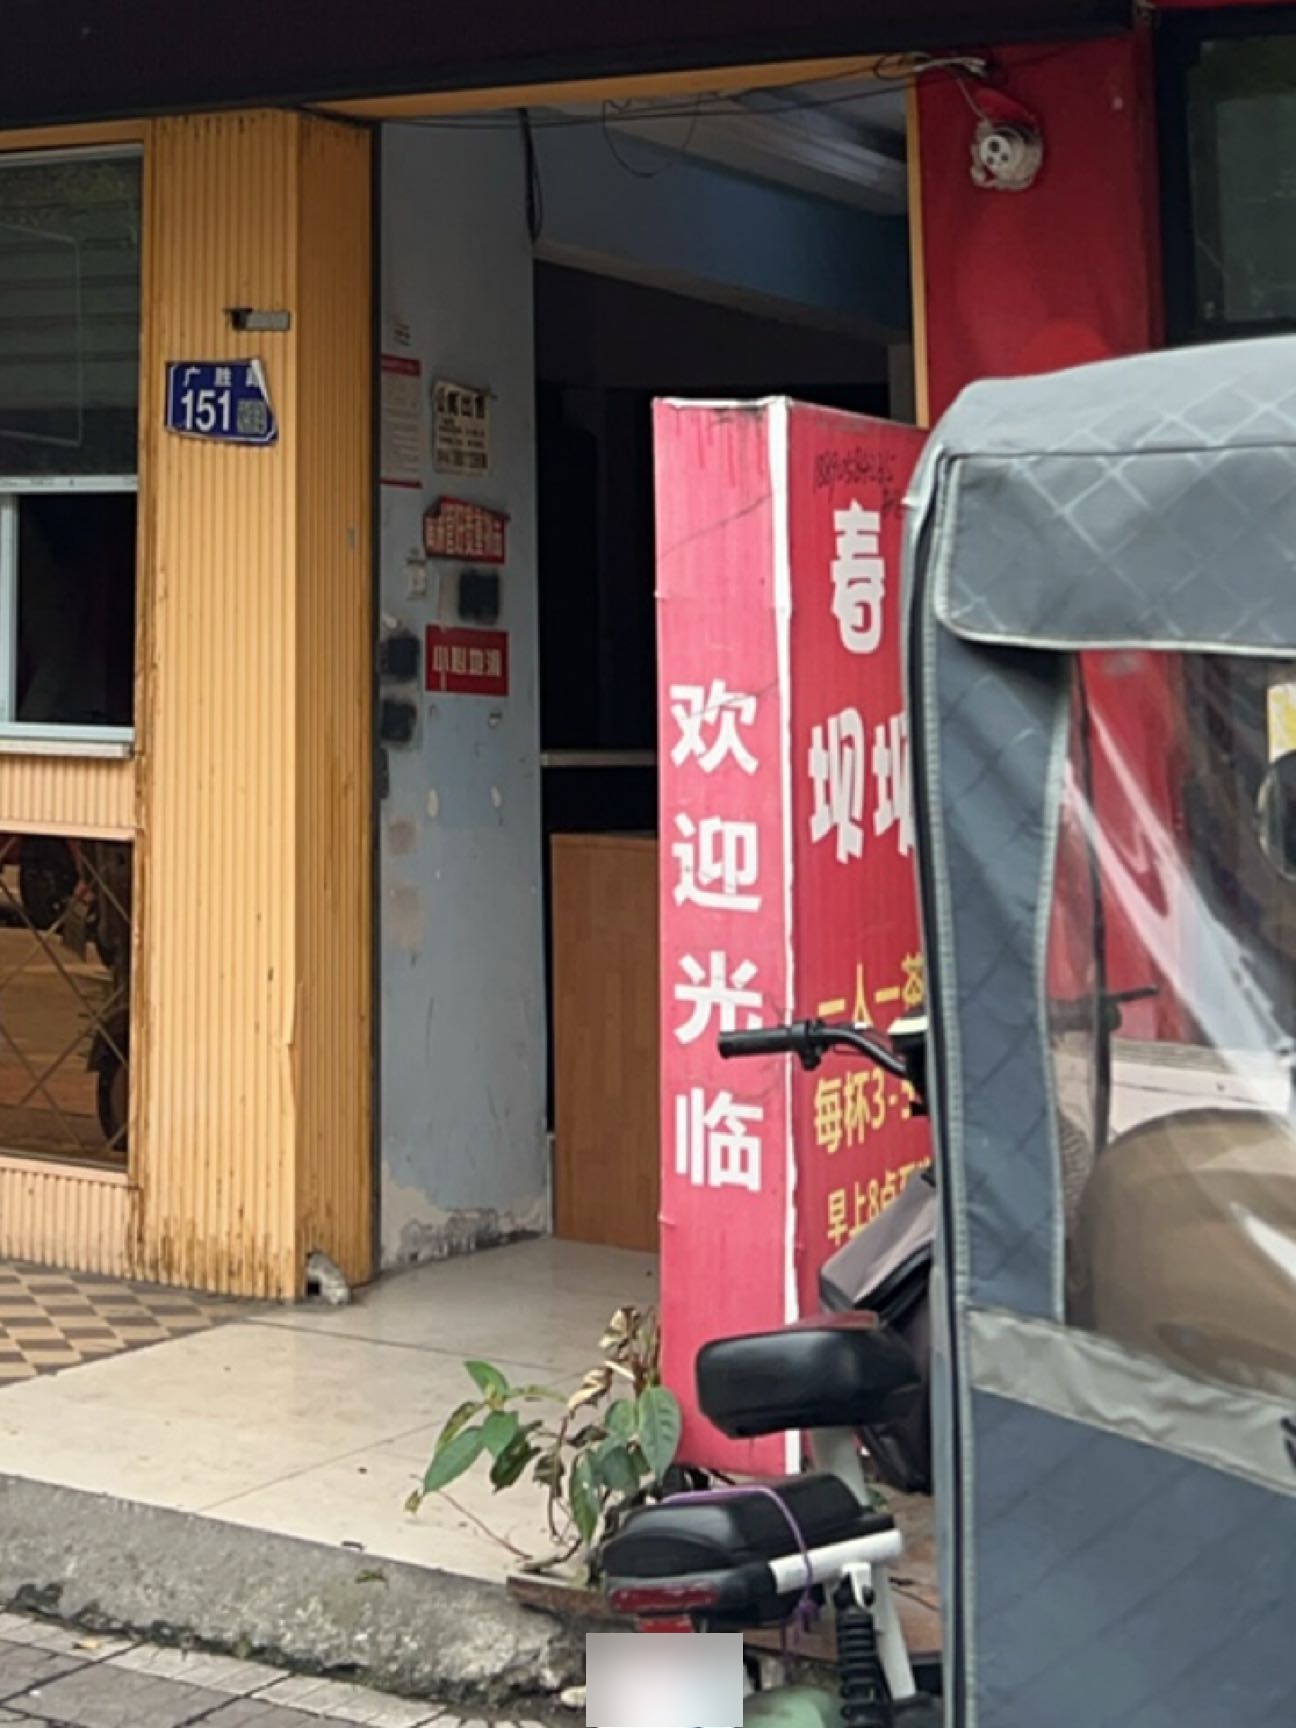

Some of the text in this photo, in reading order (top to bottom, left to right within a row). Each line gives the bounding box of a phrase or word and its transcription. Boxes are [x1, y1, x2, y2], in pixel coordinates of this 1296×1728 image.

[181, 388, 232, 432] 151
[670, 678, 764, 1192] 欢迎光临
